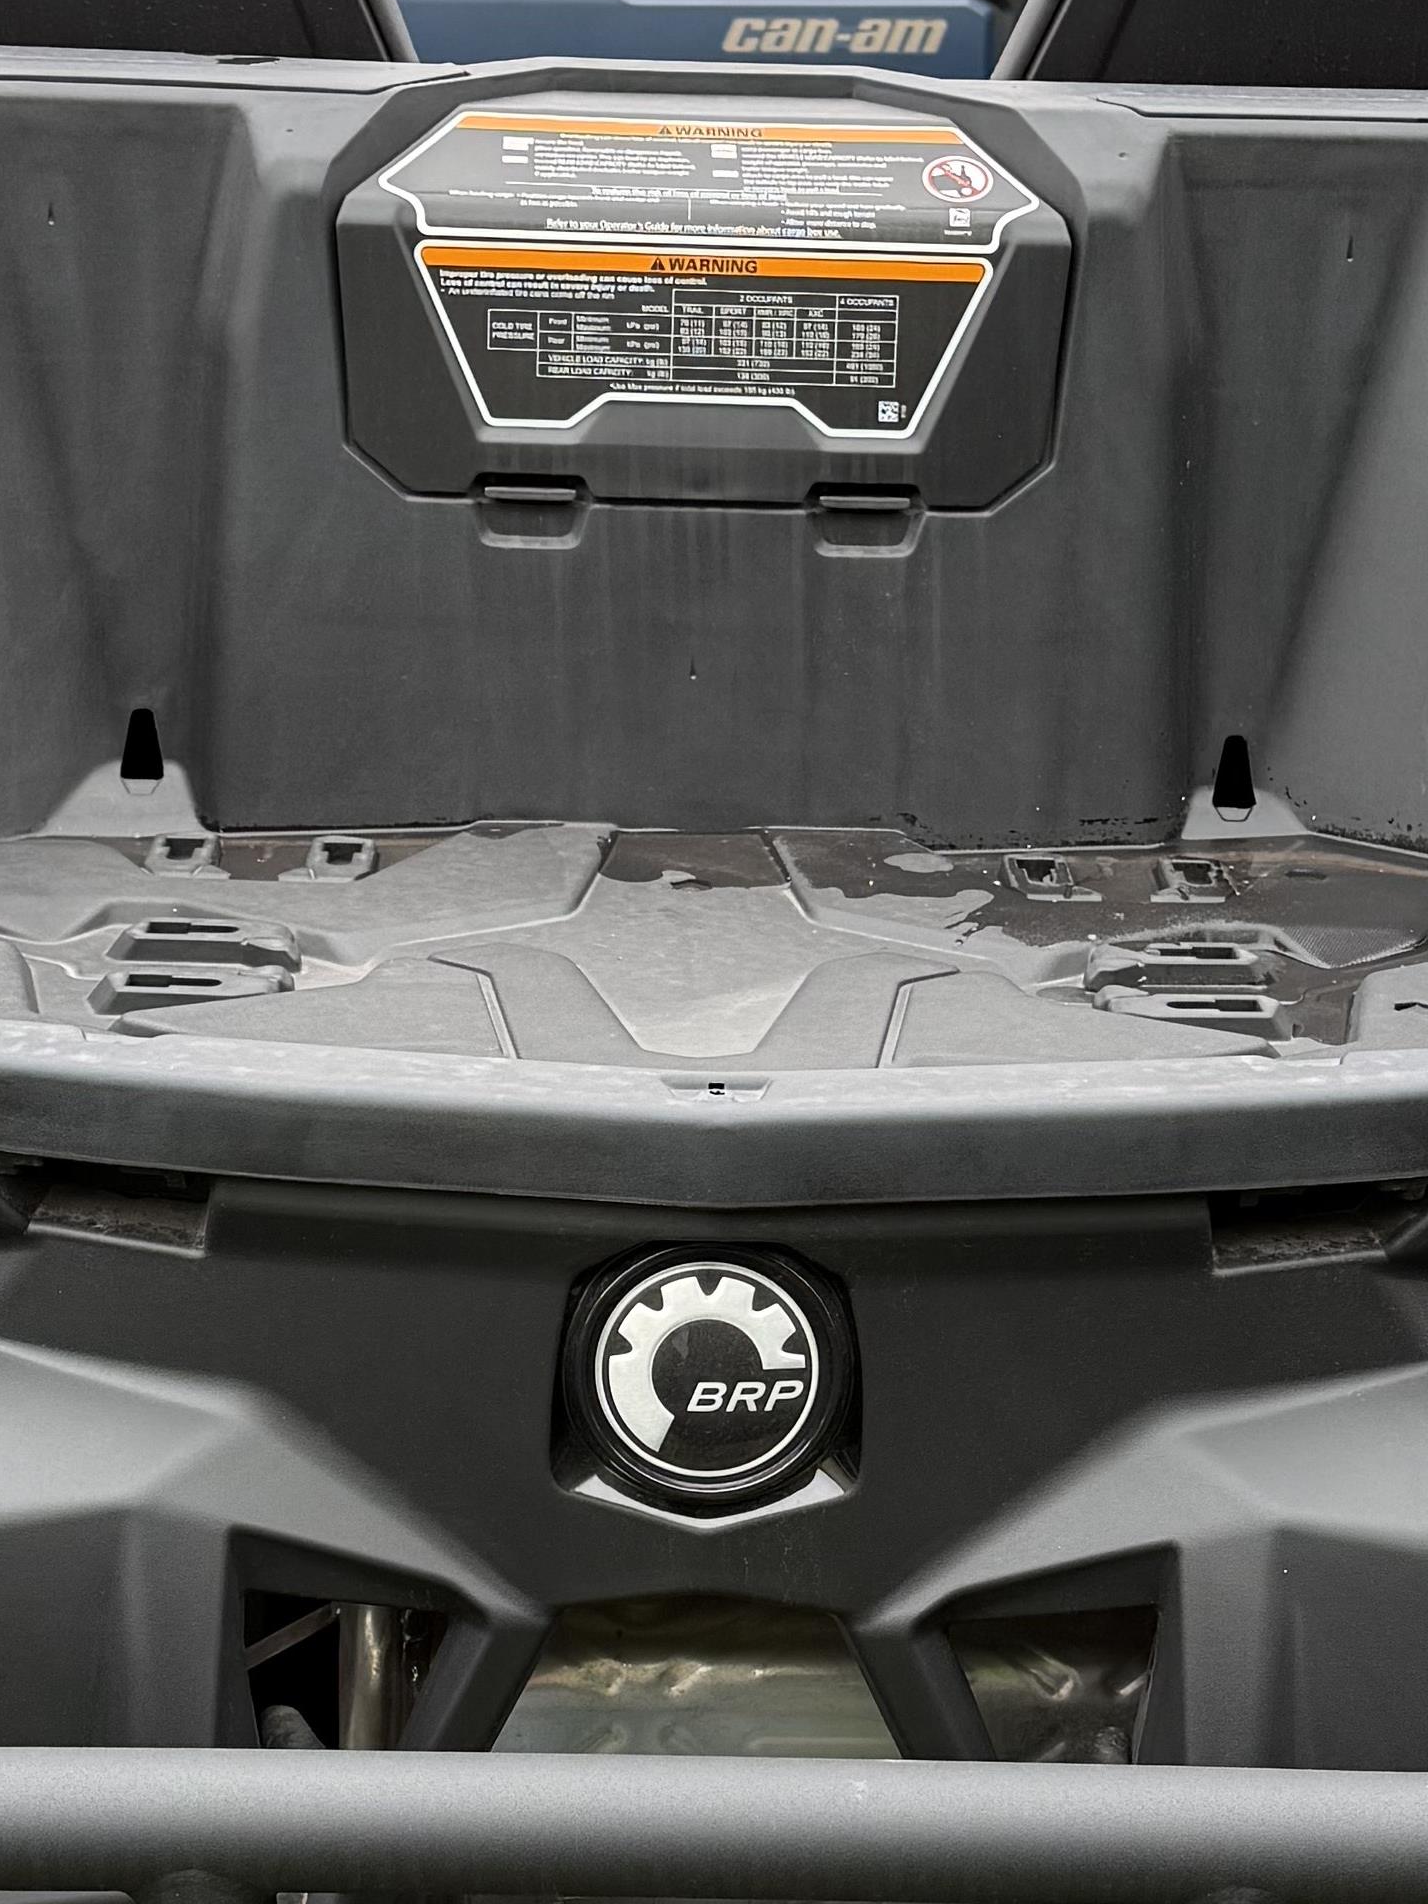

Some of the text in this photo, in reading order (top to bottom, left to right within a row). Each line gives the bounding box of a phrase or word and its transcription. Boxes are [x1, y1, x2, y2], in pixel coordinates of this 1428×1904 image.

[722, 17, 948, 54] can-am
[675, 125, 763, 138] WARNING
[668, 257, 758, 274] WARNING
[641, 304, 669, 313] MODEL
[686, 1379, 804, 1413] BRP
